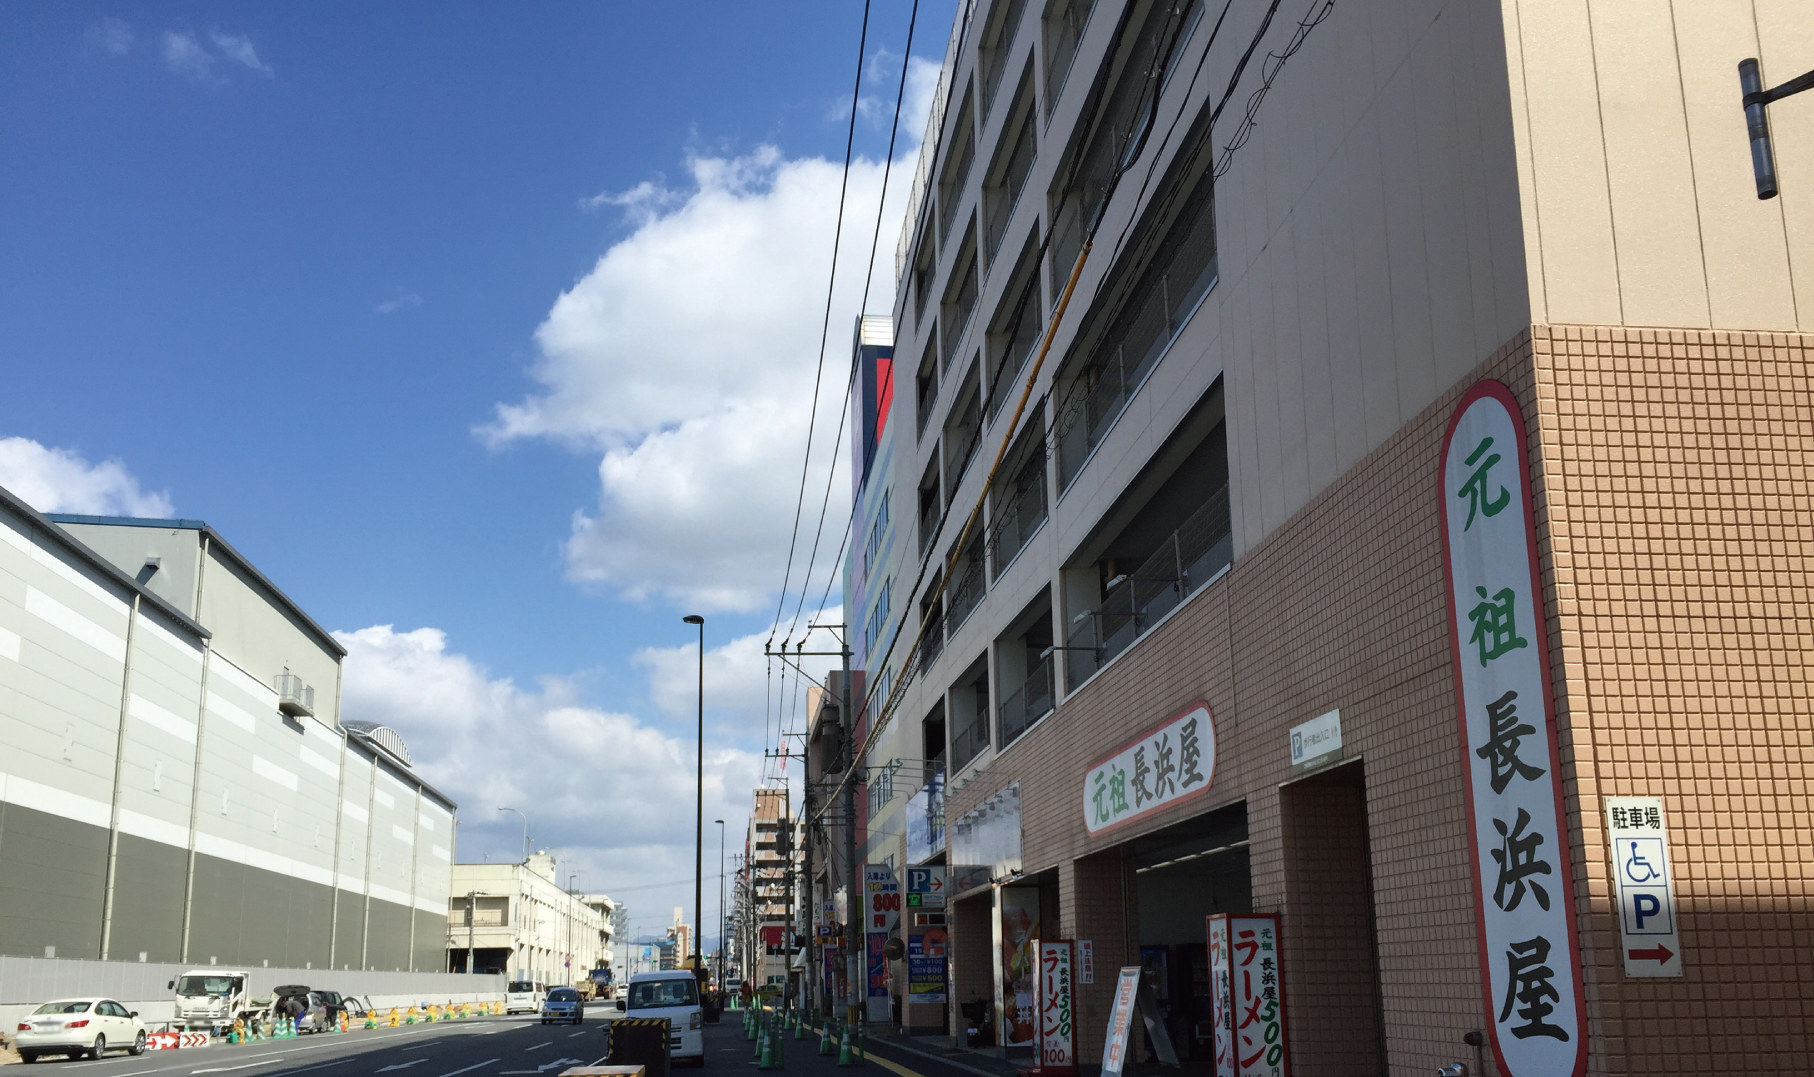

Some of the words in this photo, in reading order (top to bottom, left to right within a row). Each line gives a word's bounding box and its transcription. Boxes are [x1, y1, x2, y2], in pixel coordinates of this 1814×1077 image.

[1092, 717, 1205, 826] 元祖長浜屋
[1458, 437, 1570, 1043] 元祖長浜屋
[1611, 806, 1662, 831] 駐車場
[873, 893, 900, 912] 800
[912, 871, 926, 890] P
[1634, 893, 1661, 929] P
[1043, 949, 1060, 1037] ラーメン
[1109, 978, 1133, 1067] 営業中
[1211, 930, 1227, 1066] ラーメン
[1234, 929, 1266, 1069] ラーメン
